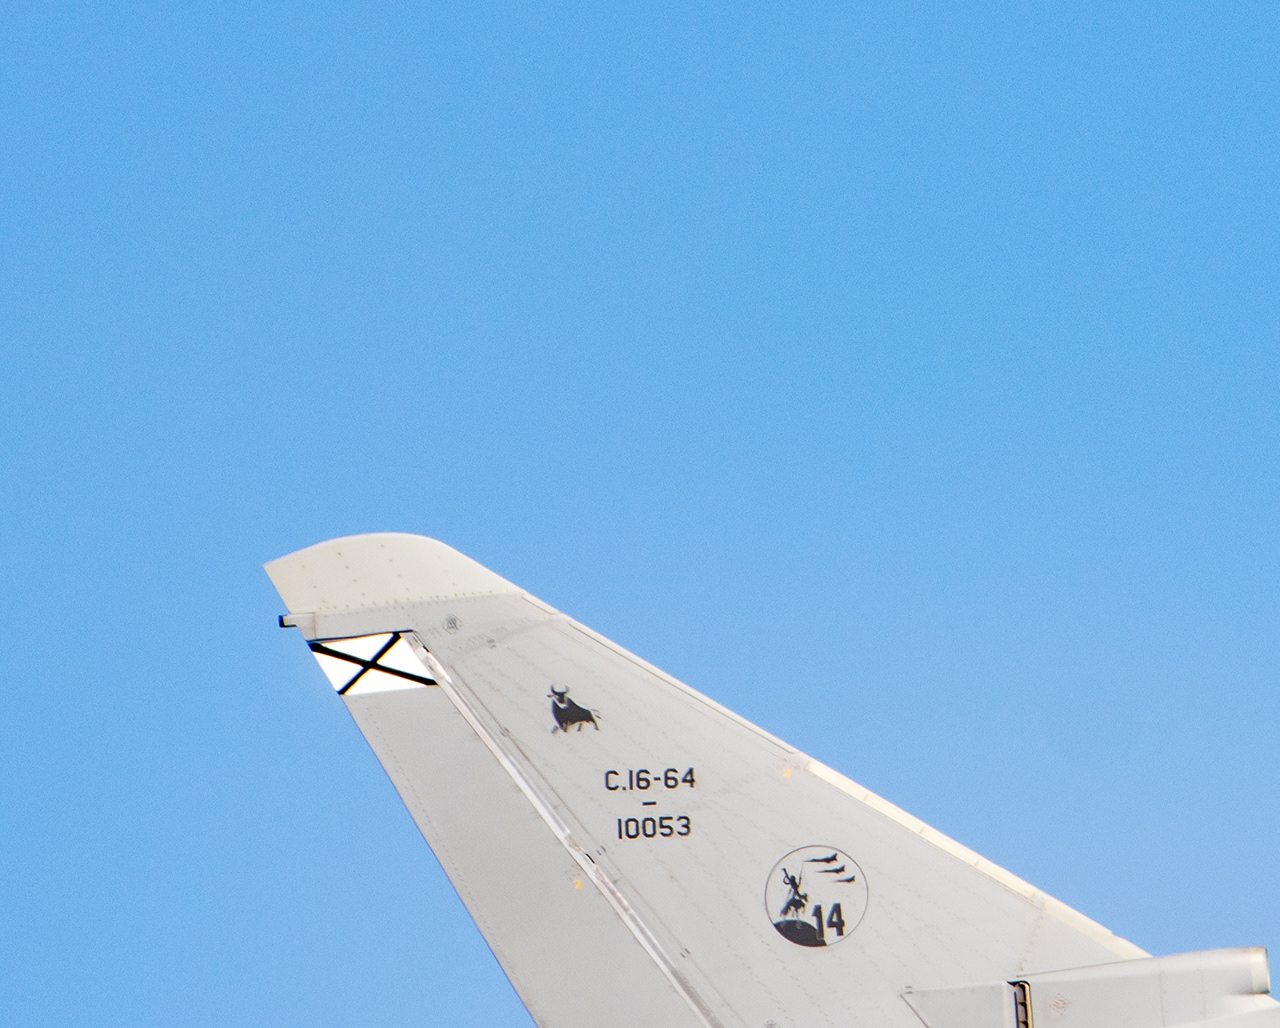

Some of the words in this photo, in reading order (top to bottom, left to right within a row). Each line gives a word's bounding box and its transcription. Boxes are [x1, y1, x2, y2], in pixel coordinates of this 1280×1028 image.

[604, 767, 696, 791] C.16-64
[617, 815, 692, 840] 10053
[811, 902, 846, 940] 14
